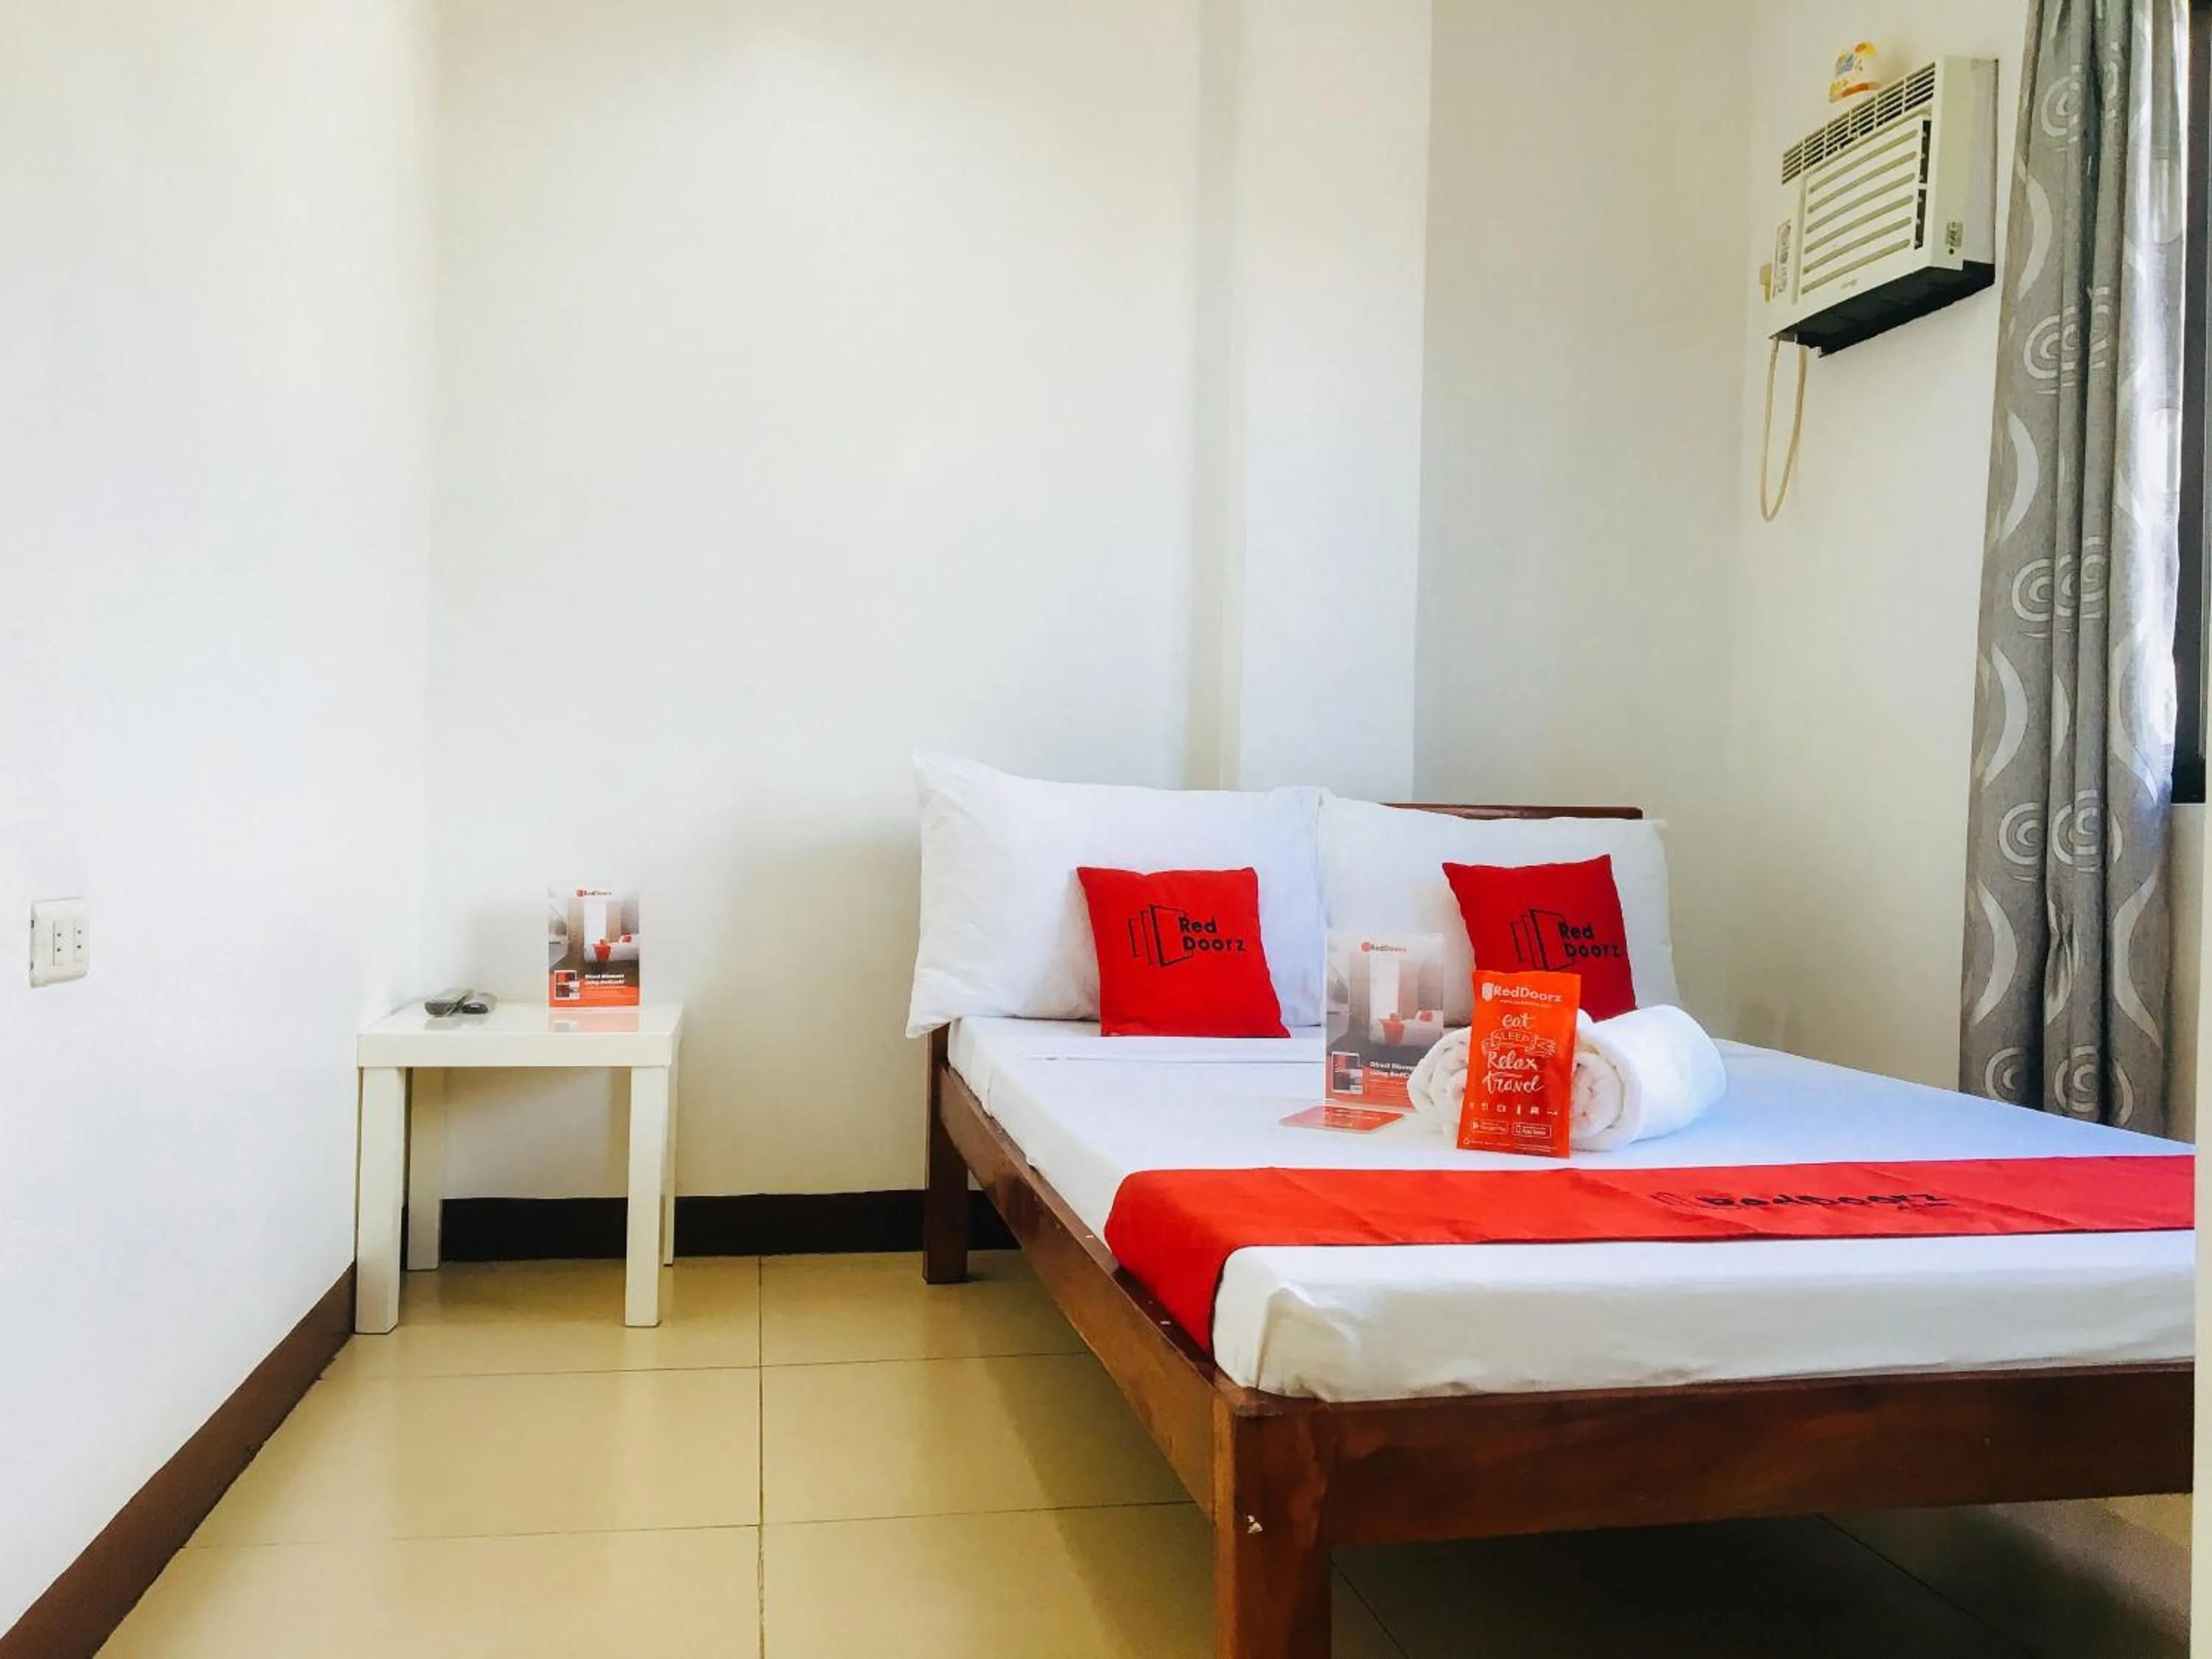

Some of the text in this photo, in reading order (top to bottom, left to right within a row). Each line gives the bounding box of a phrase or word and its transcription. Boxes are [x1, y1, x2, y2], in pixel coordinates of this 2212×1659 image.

[1179, 916, 1217, 933] Red
[1559, 922, 1594, 939] Red
[1183, 936, 1245, 951] Doorz
[1564, 944, 1621, 957] Doorz
[1493, 985, 1562, 1002] RedDoorz
[1502, 1012, 1533, 1029] eat
[1495, 1032, 1530, 1042] SLEEP
[1487, 1050, 1537, 1071] Relax
